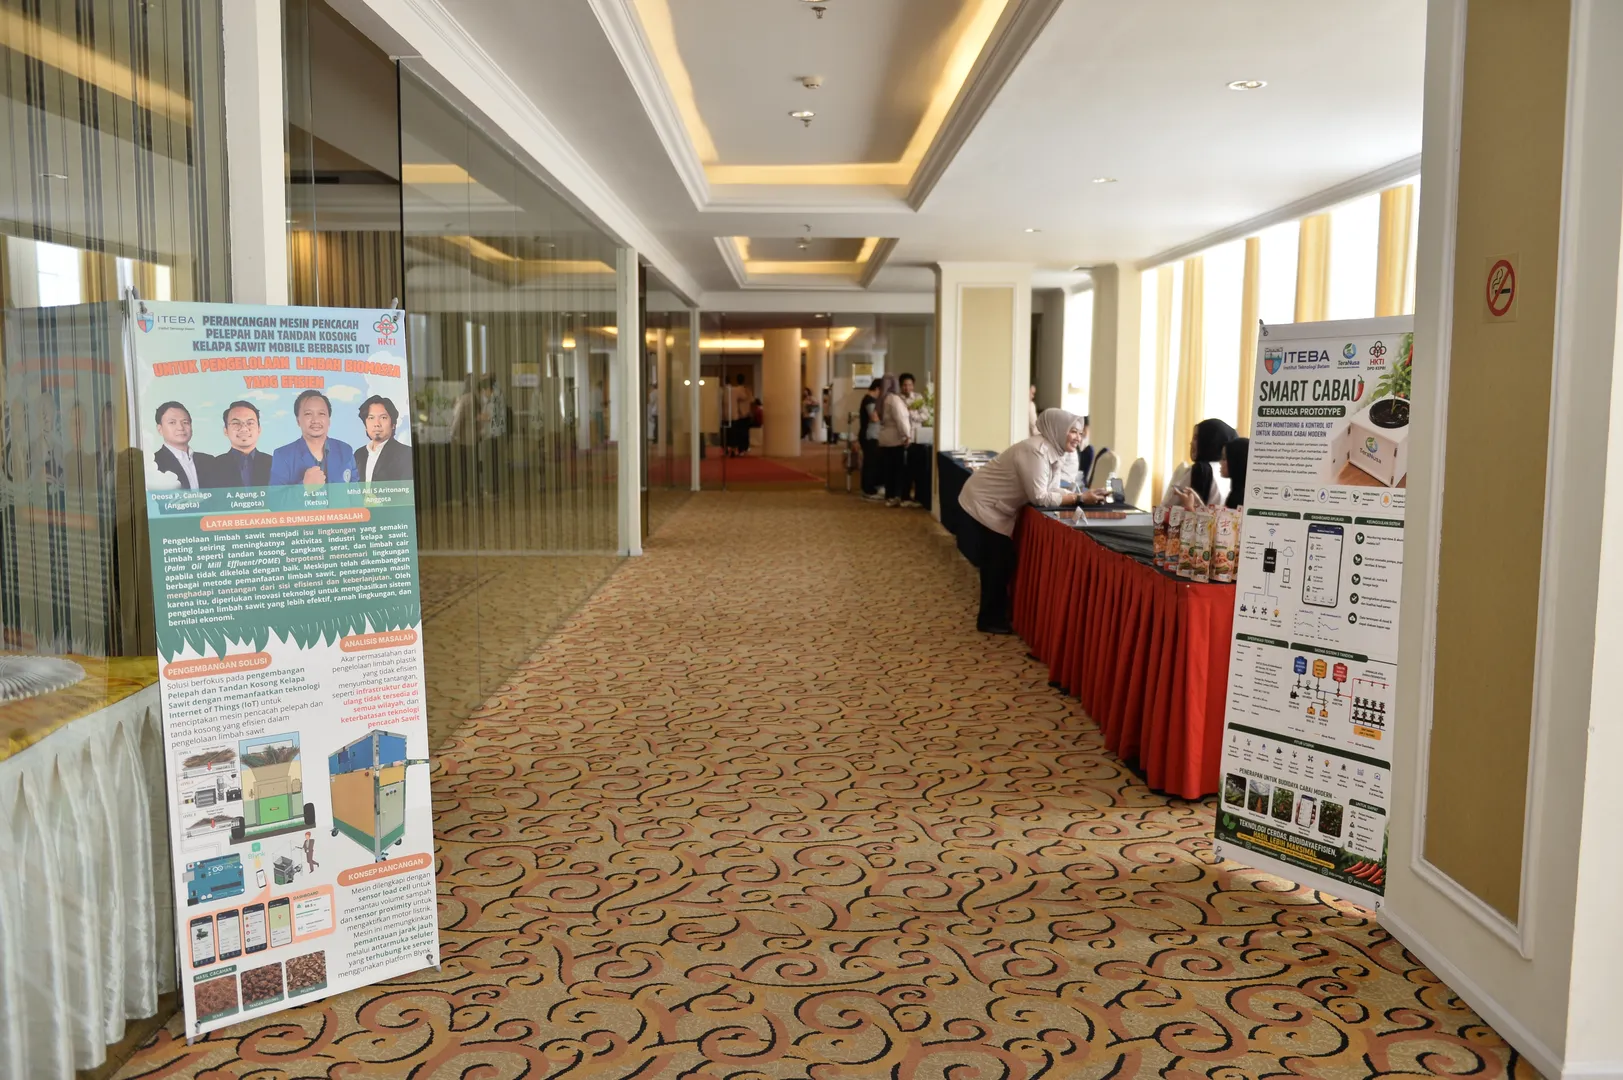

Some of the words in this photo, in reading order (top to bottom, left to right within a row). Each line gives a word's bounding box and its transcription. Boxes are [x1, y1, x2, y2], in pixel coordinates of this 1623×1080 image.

[157, 316, 195, 324] ITEBA
[203, 316, 276, 327] PERANCANGAN
[280, 318, 309, 328] MESIN
[312, 319, 358, 329] PENCACAH
[206, 329, 250, 339] PELEPAH
[254, 330, 274, 340] DAN
[277, 331, 316, 340] TANDAN
[320, 331, 356, 341] KOSONG
[193, 341, 232, 351] KELAPA
[235, 342, 265, 352] SAWIT
[269, 343, 305, 352] MOBILE
[308, 343, 353, 353] BERBASIS
[356, 344, 370, 353] IOT
[1284, 350, 1330, 363] ITEBA
[153, 360, 199, 377] UNTUK
[200, 356, 290, 373] PENGELOLAAN
[296, 357, 342, 371] LIMBAH
[345, 359, 400, 378] BIOMASSA
[243, 375, 278, 389] YANG
[281, 375, 324, 388] EFISIEN
[1259, 380, 1308, 401] SMART
[1313, 379, 1356, 401] CABAI
[1360, 448, 1381, 463] TeraNusa
[183, 492, 212, 500] Caniago
[165, 502, 200, 510] (Anggota)
[231, 500, 264, 508] (Anggota)
[206, 520, 233, 528] LATAR
[235, 518, 277, 526] BELAKANG
[287, 515, 325, 523] RUMUSAN
[327, 513, 363, 521] MASALAH
[163, 536, 209, 545] Pengelolaan
[245, 531, 265, 539] sawit
[270, 530, 299, 539] menjadi
[318, 527, 356, 536] lingkungan
[163, 547, 193, 555] penting
[232, 540, 285, 550] meningkatnya
[344, 639, 378, 648] ANALISIS
[378, 634, 414, 643] MASALAH
[357, 649, 402, 661] permasalahan
[168, 661, 237, 676] PENGEMBANGAN
[238, 657, 268, 667] SOLUSI
[332, 662, 372, 674] pengelolaan
[372, 659, 394, 667] limbah
[396, 657, 416, 665] plastik
[167, 682, 189, 690] Solusi
[191, 678, 224, 687] berfokus
[246, 667, 305, 680] pengembangan
[362, 670, 377, 678] yang
[168, 690, 199, 700] Pelepah
[219, 684, 248, 692] Tandan
[250, 680, 278, 688] Kosong
[280, 676, 305, 684] Kelapa
[338, 678, 382, 690] menyumbang
[384, 674, 418, 683] tantangan,
[168, 701, 190, 709] Sawit
[192, 697, 222, 706] dengan
[224, 688, 283, 701] memanfaatkan
[286, 683, 320, 693] teknologi
[332, 690, 355, 700] seperti
[356, 684, 400, 695] infrastruktur
[1239, 768, 1263, 778] PENERAPAN
[1264, 774, 1277, 783] UNTUK
[1278, 779, 1298, 789] BUDIDAYA
[1300, 785, 1313, 793] CABAI
[1314, 789, 1332, 798] MODERN
[1240, 819, 1266, 834] TEKNOLOGI
[1253, 831, 1268, 840] HASIL
[1270, 837, 1286, 847] LEBIH
[1287, 841, 1317, 857] MAKSIMAL
[348, 869, 378, 881] KONSEP
[378, 858, 424, 874] RANCANGAN
[352, 886, 371, 895] Mesin
[373, 878, 405, 890] dilengkapi
[406, 872, 431, 882] dengan
[358, 892, 384, 902] sensor
[383, 888, 397, 896] load
[412, 880, 431, 889] untuk
[293, 891, 319, 900] DASHBOARD
[344, 902, 379, 915] memantau
[381, 895, 404, 905] volume
[406, 889, 431, 900] sampah
[340, 917, 353, 925] dan
[354, 911, 377, 921] sensor
[379, 901, 412, 916] proximity
[413, 897, 432, 905] untuk
[210, 967, 232, 977] CACAHAN
